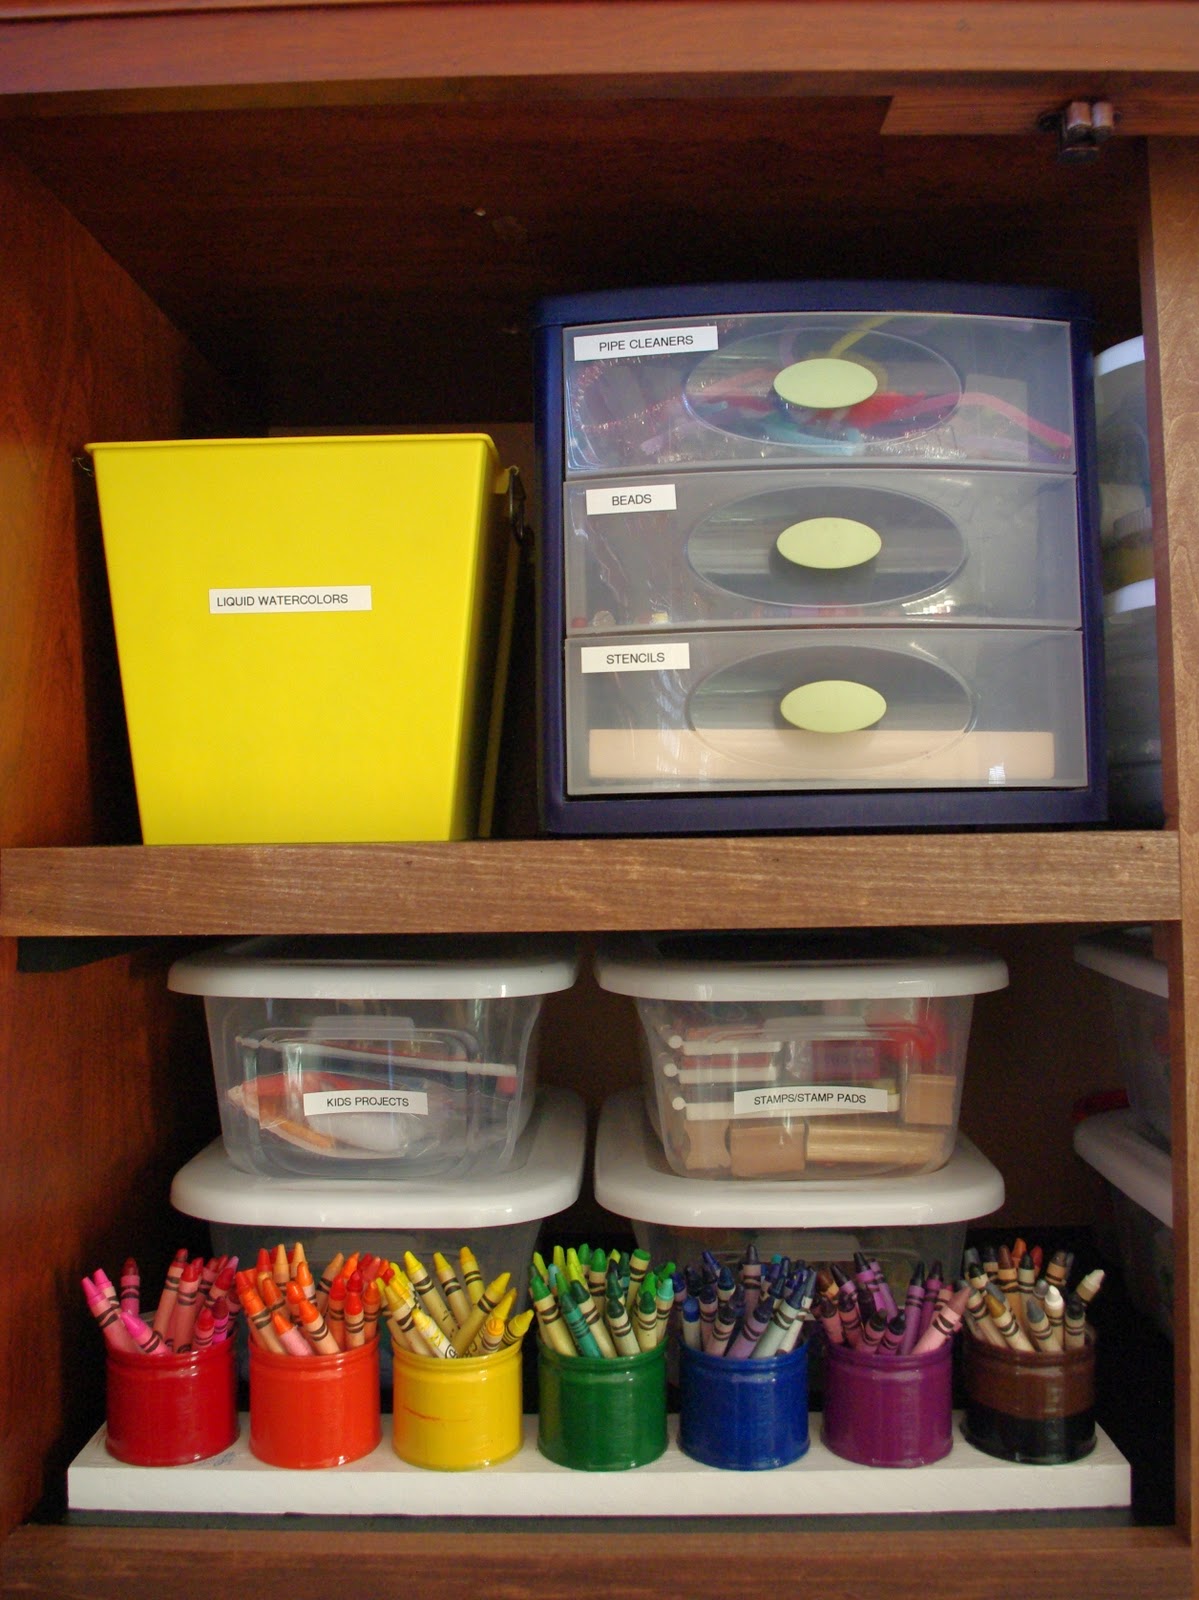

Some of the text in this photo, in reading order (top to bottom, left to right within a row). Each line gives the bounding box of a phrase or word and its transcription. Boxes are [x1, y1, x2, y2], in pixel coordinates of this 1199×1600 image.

[599, 335, 694, 352] PIPE CLEANERS
[612, 494, 652, 506] BEADS
[217, 594, 348, 607] LIQUID WATERCOLORS
[606, 652, 665, 664] STENCILS
[327, 1097, 409, 1107] KIDS PROJECTS
[754, 1093, 867, 1105] STAMPS/STAMP PADS
